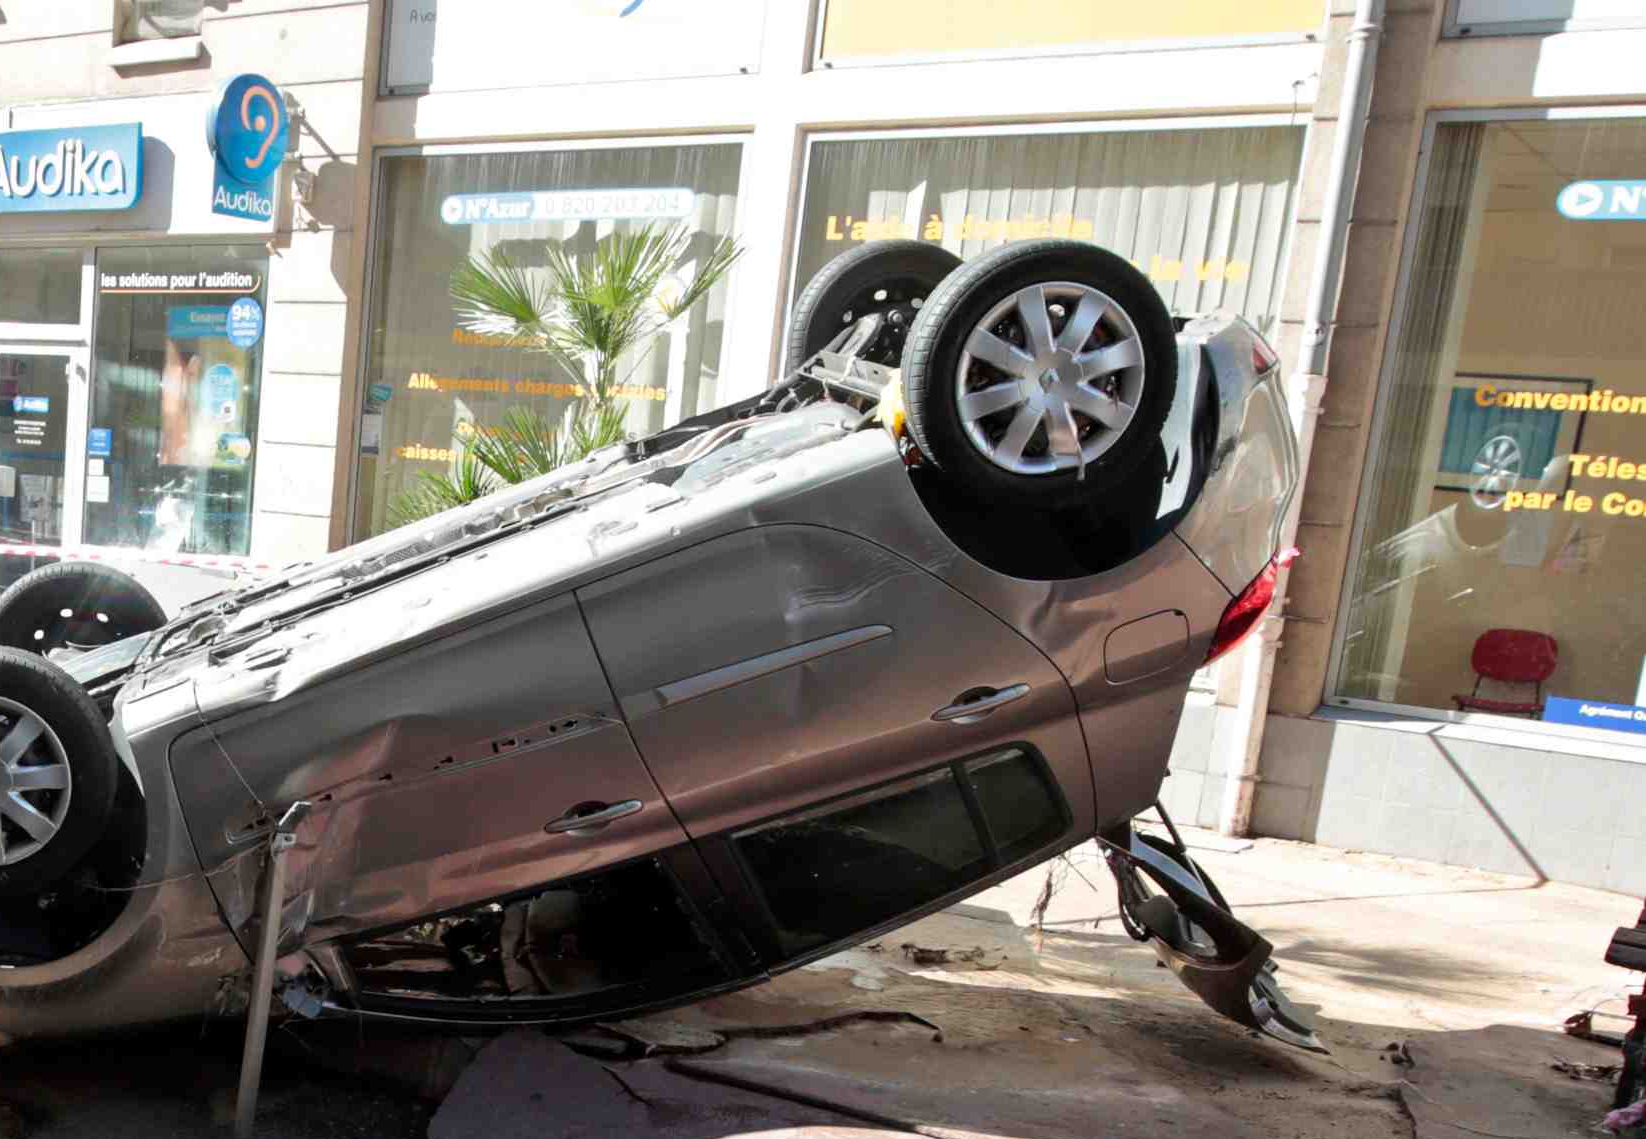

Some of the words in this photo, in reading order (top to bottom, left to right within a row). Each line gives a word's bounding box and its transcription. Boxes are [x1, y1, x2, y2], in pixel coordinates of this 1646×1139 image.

[214, 185, 273, 218] Audika
[923, 213, 942, 241] à
[101, 273, 116, 288] les
[119, 273, 168, 288] solutions
[170, 274, 197, 290] pour
[199, 272, 252, 288] l'audition
[1474, 384, 1646, 414] Convention
[1504, 489, 1557, 512] par
[1563, 489, 1593, 512] le
[1601, 491, 1646, 516] Co
